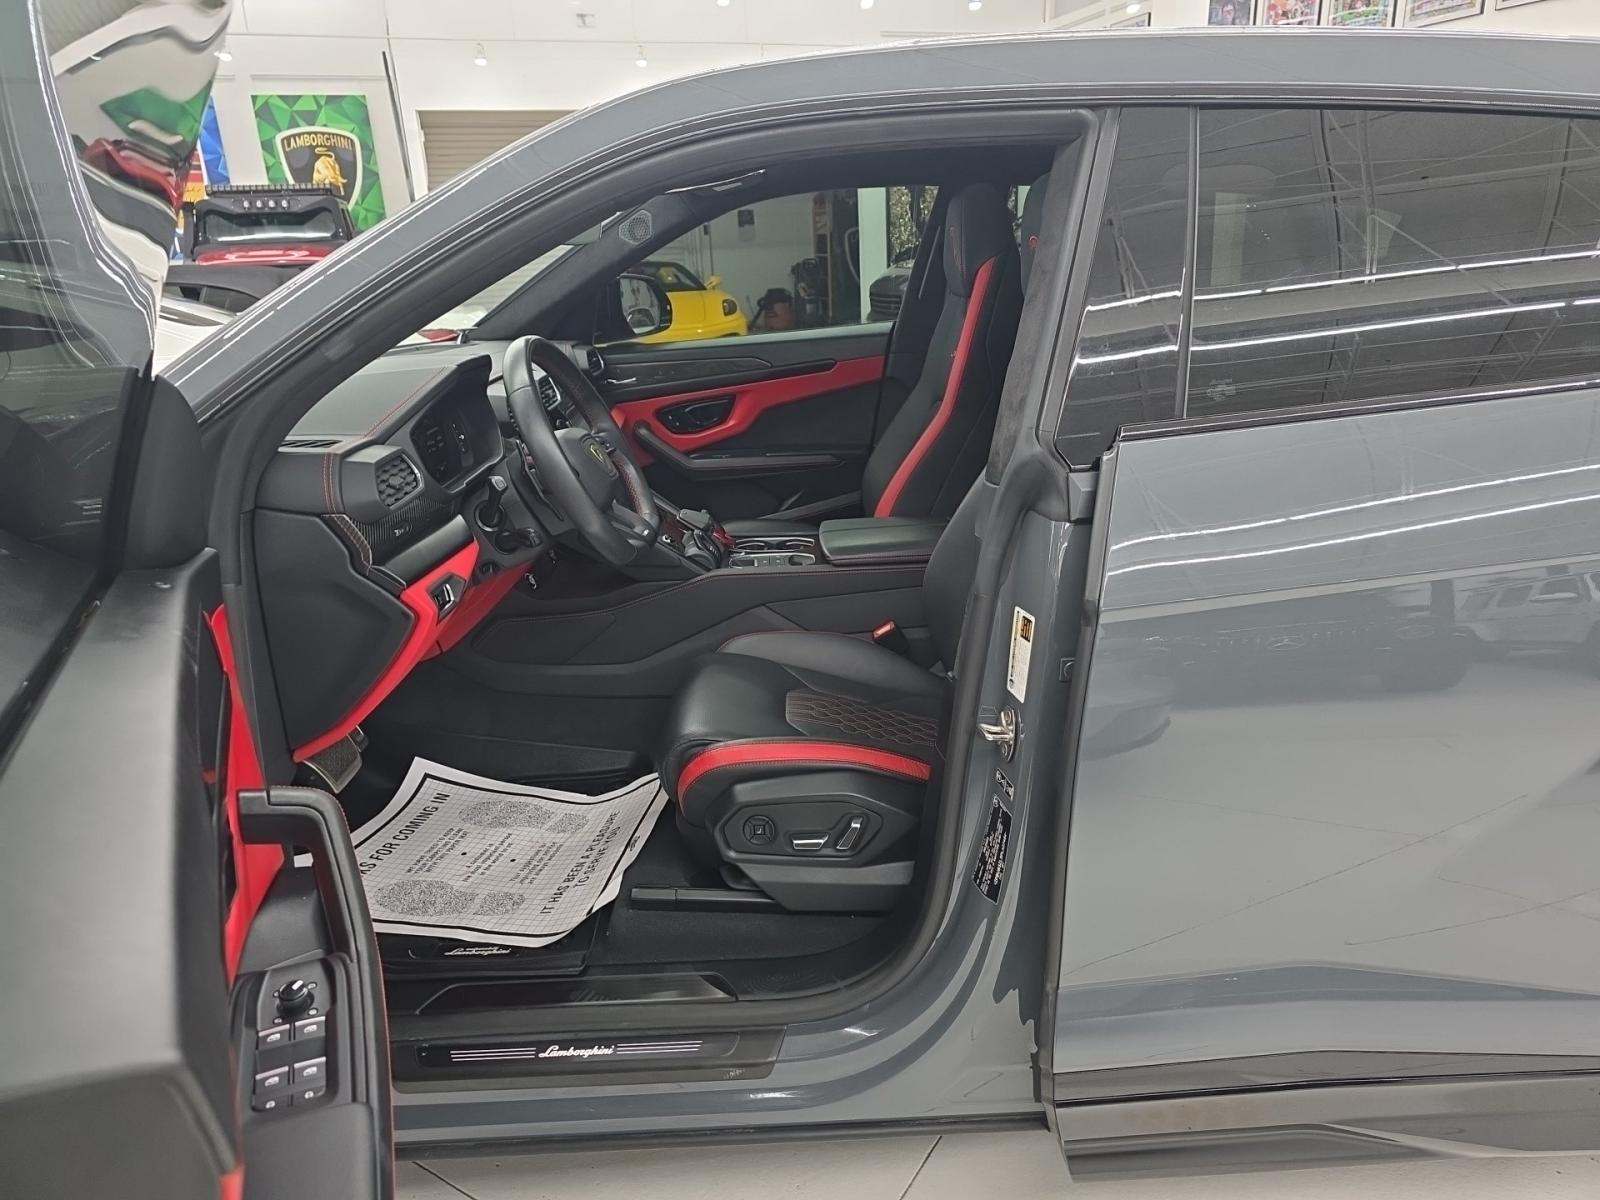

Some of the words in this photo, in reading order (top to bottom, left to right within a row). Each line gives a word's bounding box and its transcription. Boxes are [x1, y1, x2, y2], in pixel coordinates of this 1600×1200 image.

[284, 133, 352, 151] LAMBORGHINI
[369, 842, 401, 861] FOR
[392, 805, 439, 841] COMING
[430, 792, 451, 804] IN
[540, 906, 555, 914] IT
[548, 885, 570, 903] HAS
[563, 861, 587, 883] BEEN
[584, 810, 621, 852] PLEASURE
[573, 876, 590, 888] TO
[584, 846, 609, 874] SERVE
[602, 826, 621, 845] YOU
[444, 947, 511, 956] Lamborghini
[538, 1045, 615, 1059] Lamborghini
